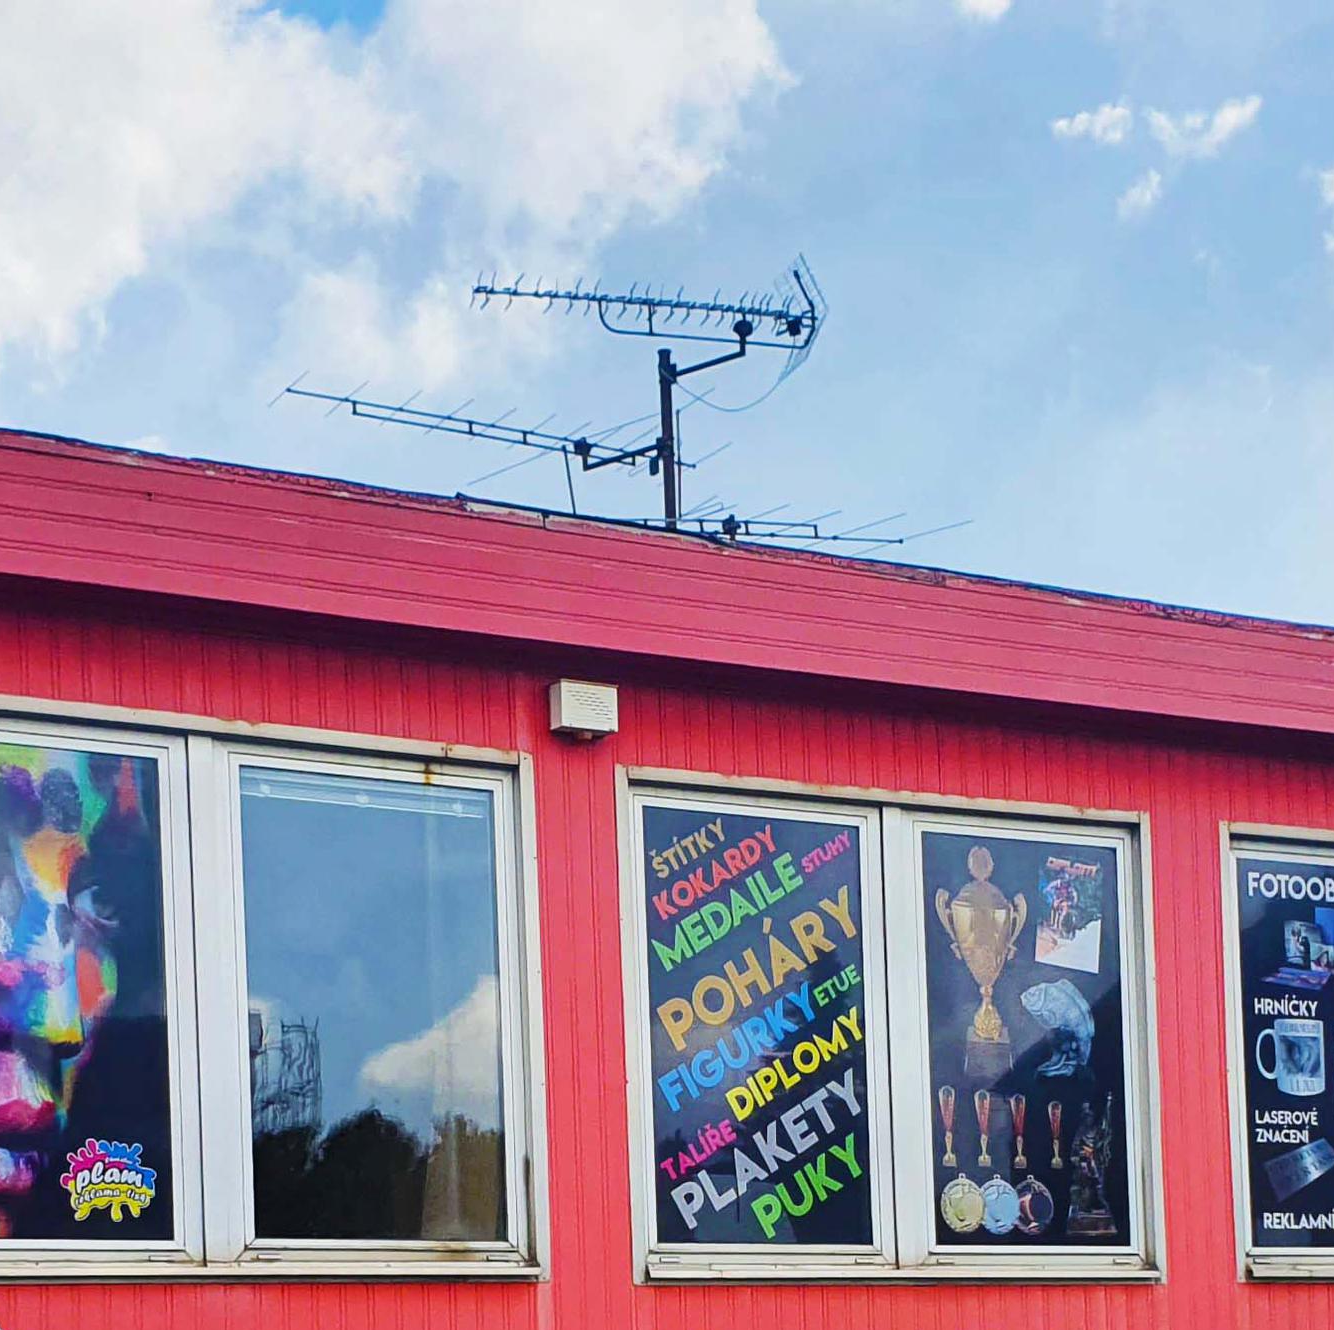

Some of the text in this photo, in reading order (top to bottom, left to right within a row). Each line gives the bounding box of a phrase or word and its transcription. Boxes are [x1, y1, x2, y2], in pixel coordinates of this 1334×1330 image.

[650, 818, 726, 879] ŠTÍTKY
[652, 824, 777, 920] KOKARDY
[651, 852, 803, 972] MEDAILE
[657, 885, 857, 1051] POHÁRY
[813, 964, 861, 1007] ETUE
[1253, 994, 1318, 1016] HRNÍČKY
[658, 982, 816, 1112] FIGURKY
[725, 1006, 863, 1122] DIPLOMY
[660, 1119, 738, 1181] TALÍŘE
[671, 1068, 862, 1230] PLAKETY
[1255, 1107, 1318, 1126] LASEROVÉ
[1255, 1125, 1309, 1143] ZNAČENÍ
[76, 1161, 143, 1193] plam
[751, 1132, 863, 1239] PUKY
